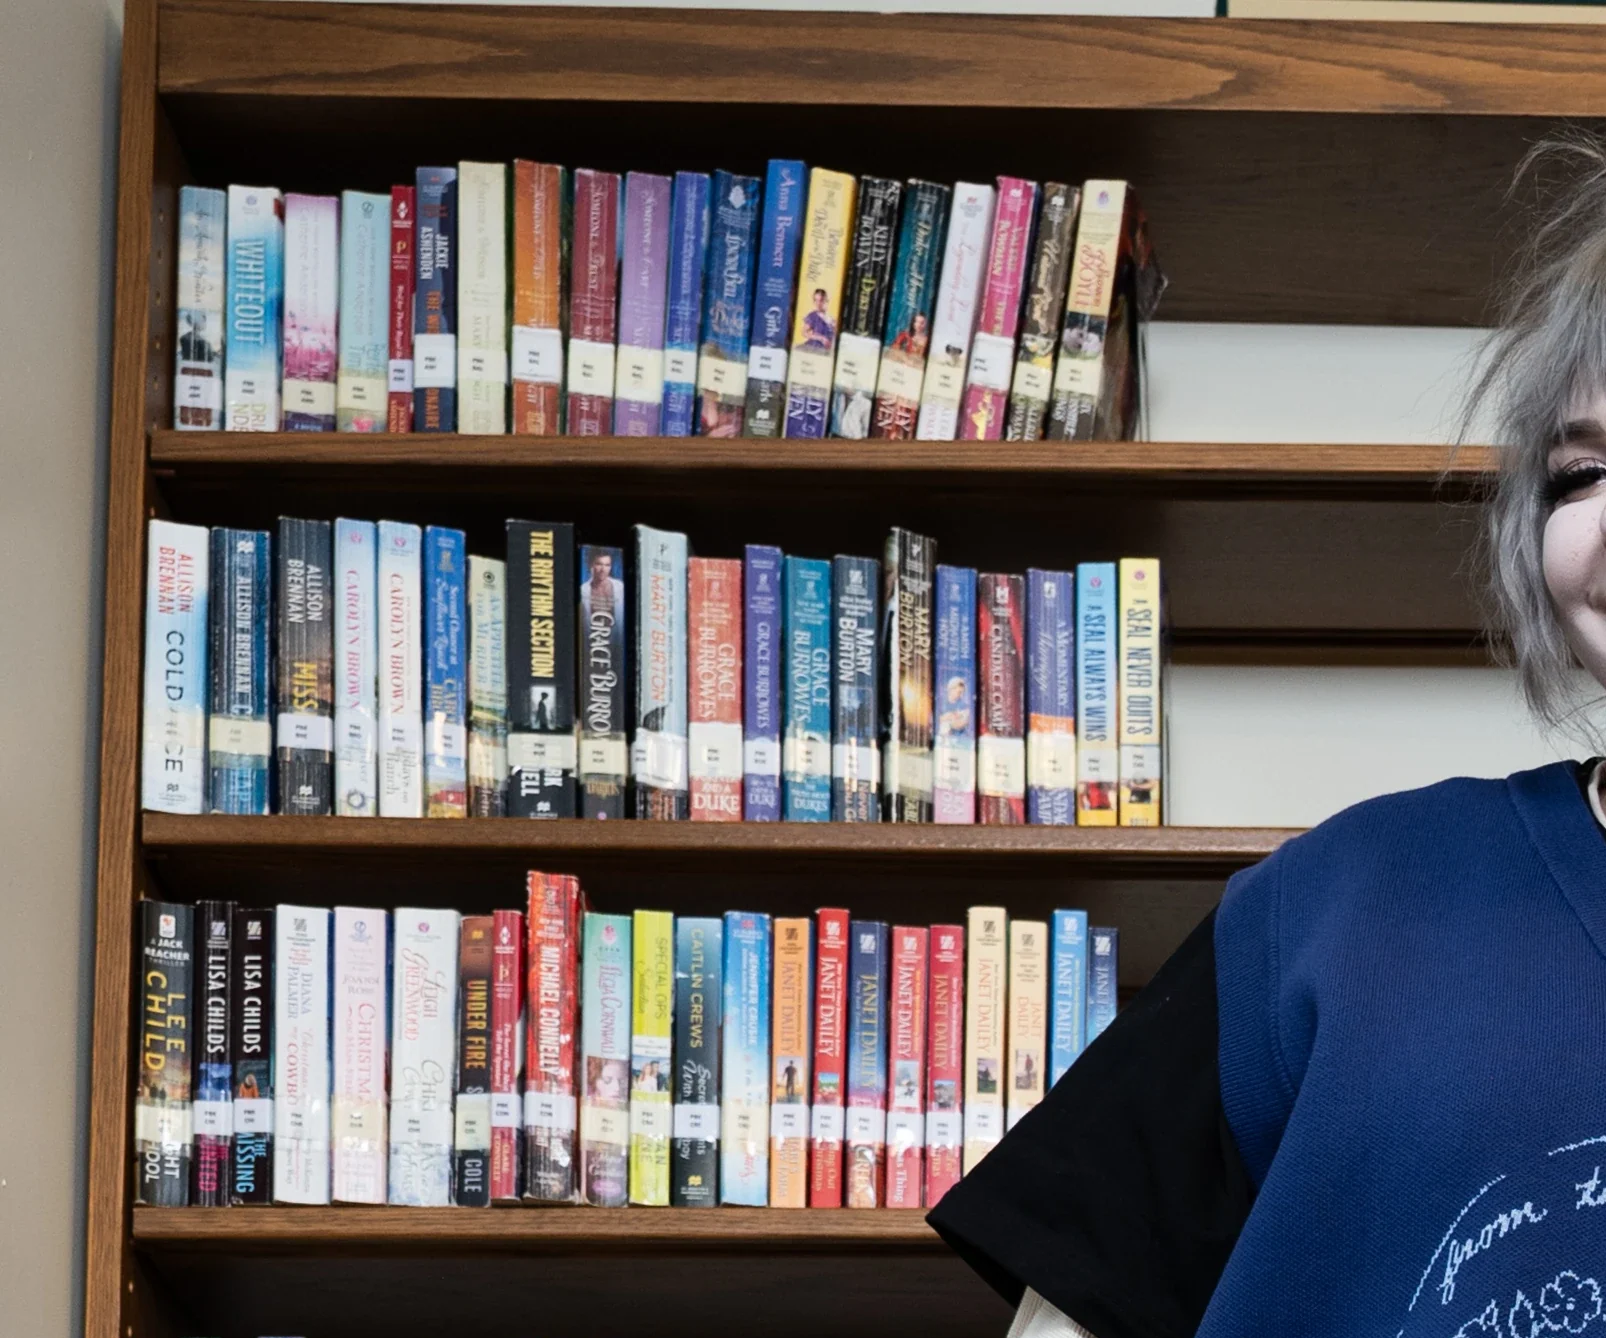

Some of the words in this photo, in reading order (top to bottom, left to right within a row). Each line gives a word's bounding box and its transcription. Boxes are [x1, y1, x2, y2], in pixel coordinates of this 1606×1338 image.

[420, 227, 433, 280] ASHENDEN
[436, 236, 450, 269] JACKIE
[772, 216, 790, 267] Bennett
[236, 241, 263, 346] WHITEOUT
[530, 531, 554, 556] THE
[157, 547, 175, 614] BRENNAN
[177, 554, 194, 612] ALLISON
[530, 558, 554, 616] RHYTHM
[651, 575, 666, 622] MARY
[389, 573, 403, 648] CAROLYN
[1126, 608, 1151, 638] SEAL
[165, 630, 183, 701] COLD
[530, 619, 554, 678] SECTION
[651, 630, 666, 701] BURTON
[698, 626, 718, 718] BURROWES
[718, 643, 736, 700] GRACE
[1127, 647, 1151, 687] NEVER
[389, 654, 403, 714] BROWN
[1127, 695, 1152, 735] QUITS
[244, 955, 262, 990] LISA
[540, 947, 560, 1003] MICHAEL
[691, 928, 702, 988] CAITLIN
[145, 971, 165, 1071] CHILD
[166, 992, 186, 1052] LEE
[244, 996, 261, 1053] CHILDS
[467, 980, 488, 1030] UNDER
[691, 993, 702, 1048] CREWS
[467, 1037, 488, 1069] FIRE
[540, 1008, 560, 1075] CONNELLY
[464, 1159, 481, 1192] COLE
[1437, 1202, 1547, 1304] from
